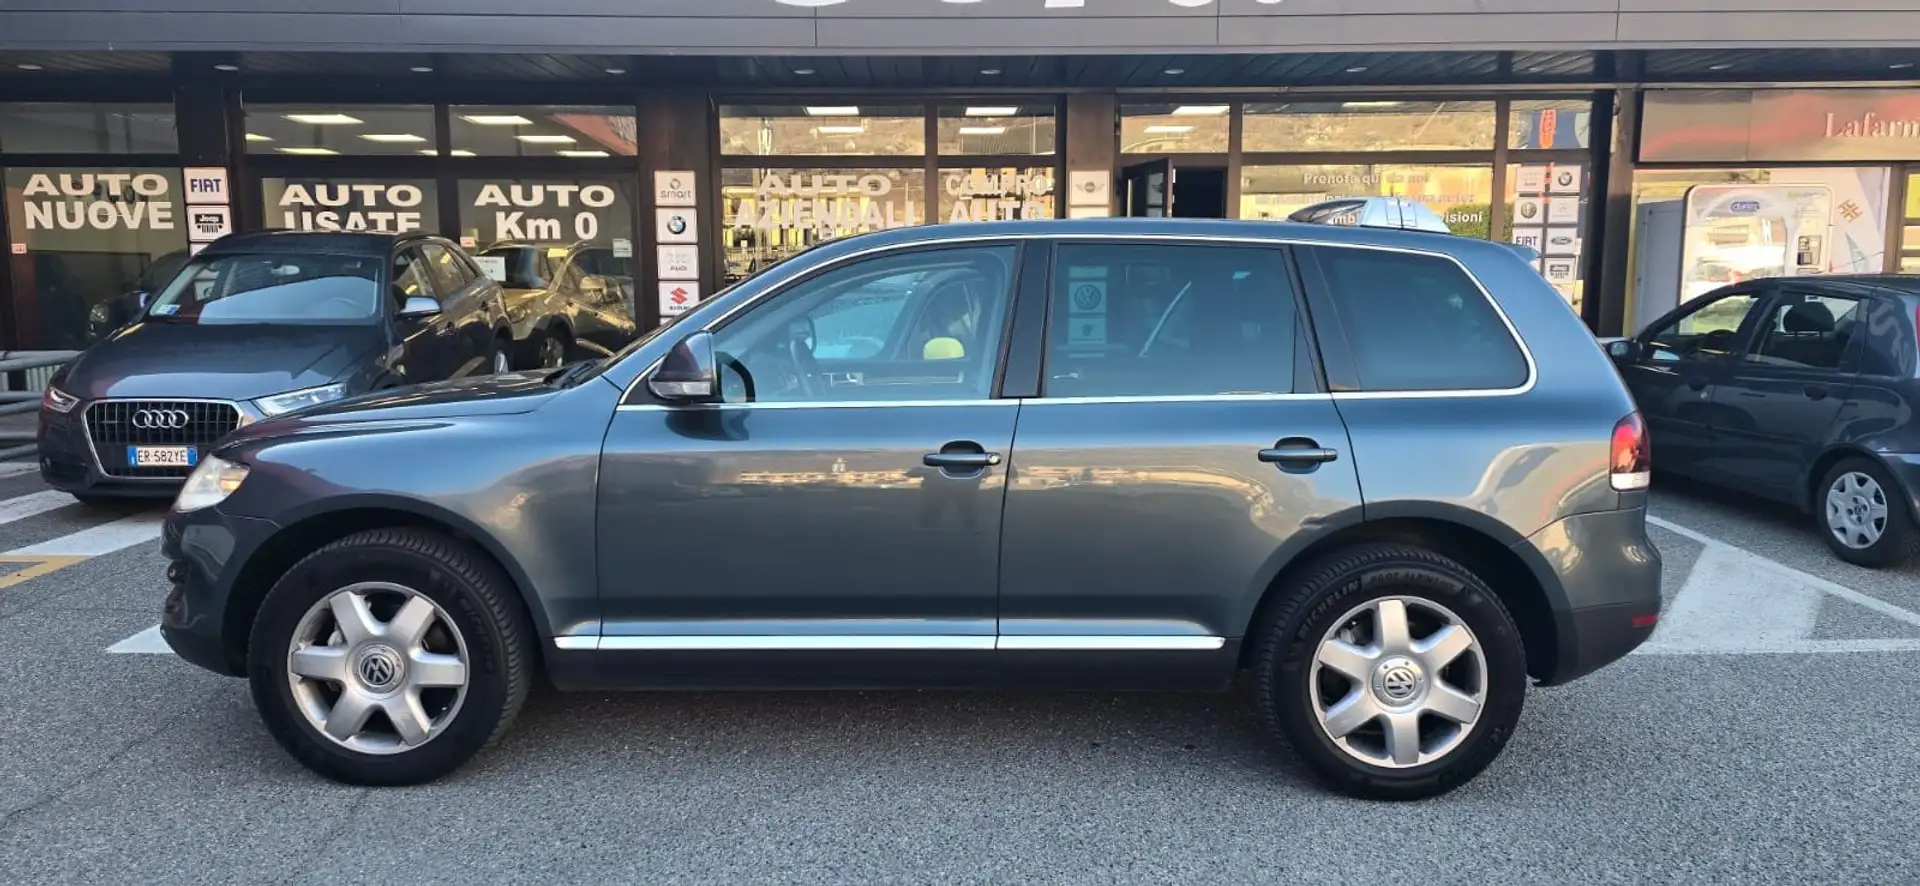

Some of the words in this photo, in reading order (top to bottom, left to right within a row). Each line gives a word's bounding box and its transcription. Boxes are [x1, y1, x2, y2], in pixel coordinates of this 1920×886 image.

[23, 174, 169, 197] AUTO
[190, 178, 222, 193] FIAT
[279, 185, 422, 207] AUTO
[474, 184, 615, 208] AUTO
[661, 190, 692, 200] smart
[756, 174, 892, 196] AUTO
[23, 202, 174, 229] NUOVE
[284, 212, 421, 232] USATE
[735, 201, 915, 229] AZIENDALI
[949, 201, 1046, 223] AUTO
[495, 212, 562, 240] Km
[574, 212, 598, 240] 0
[1515, 236, 1538, 246] FIAT
